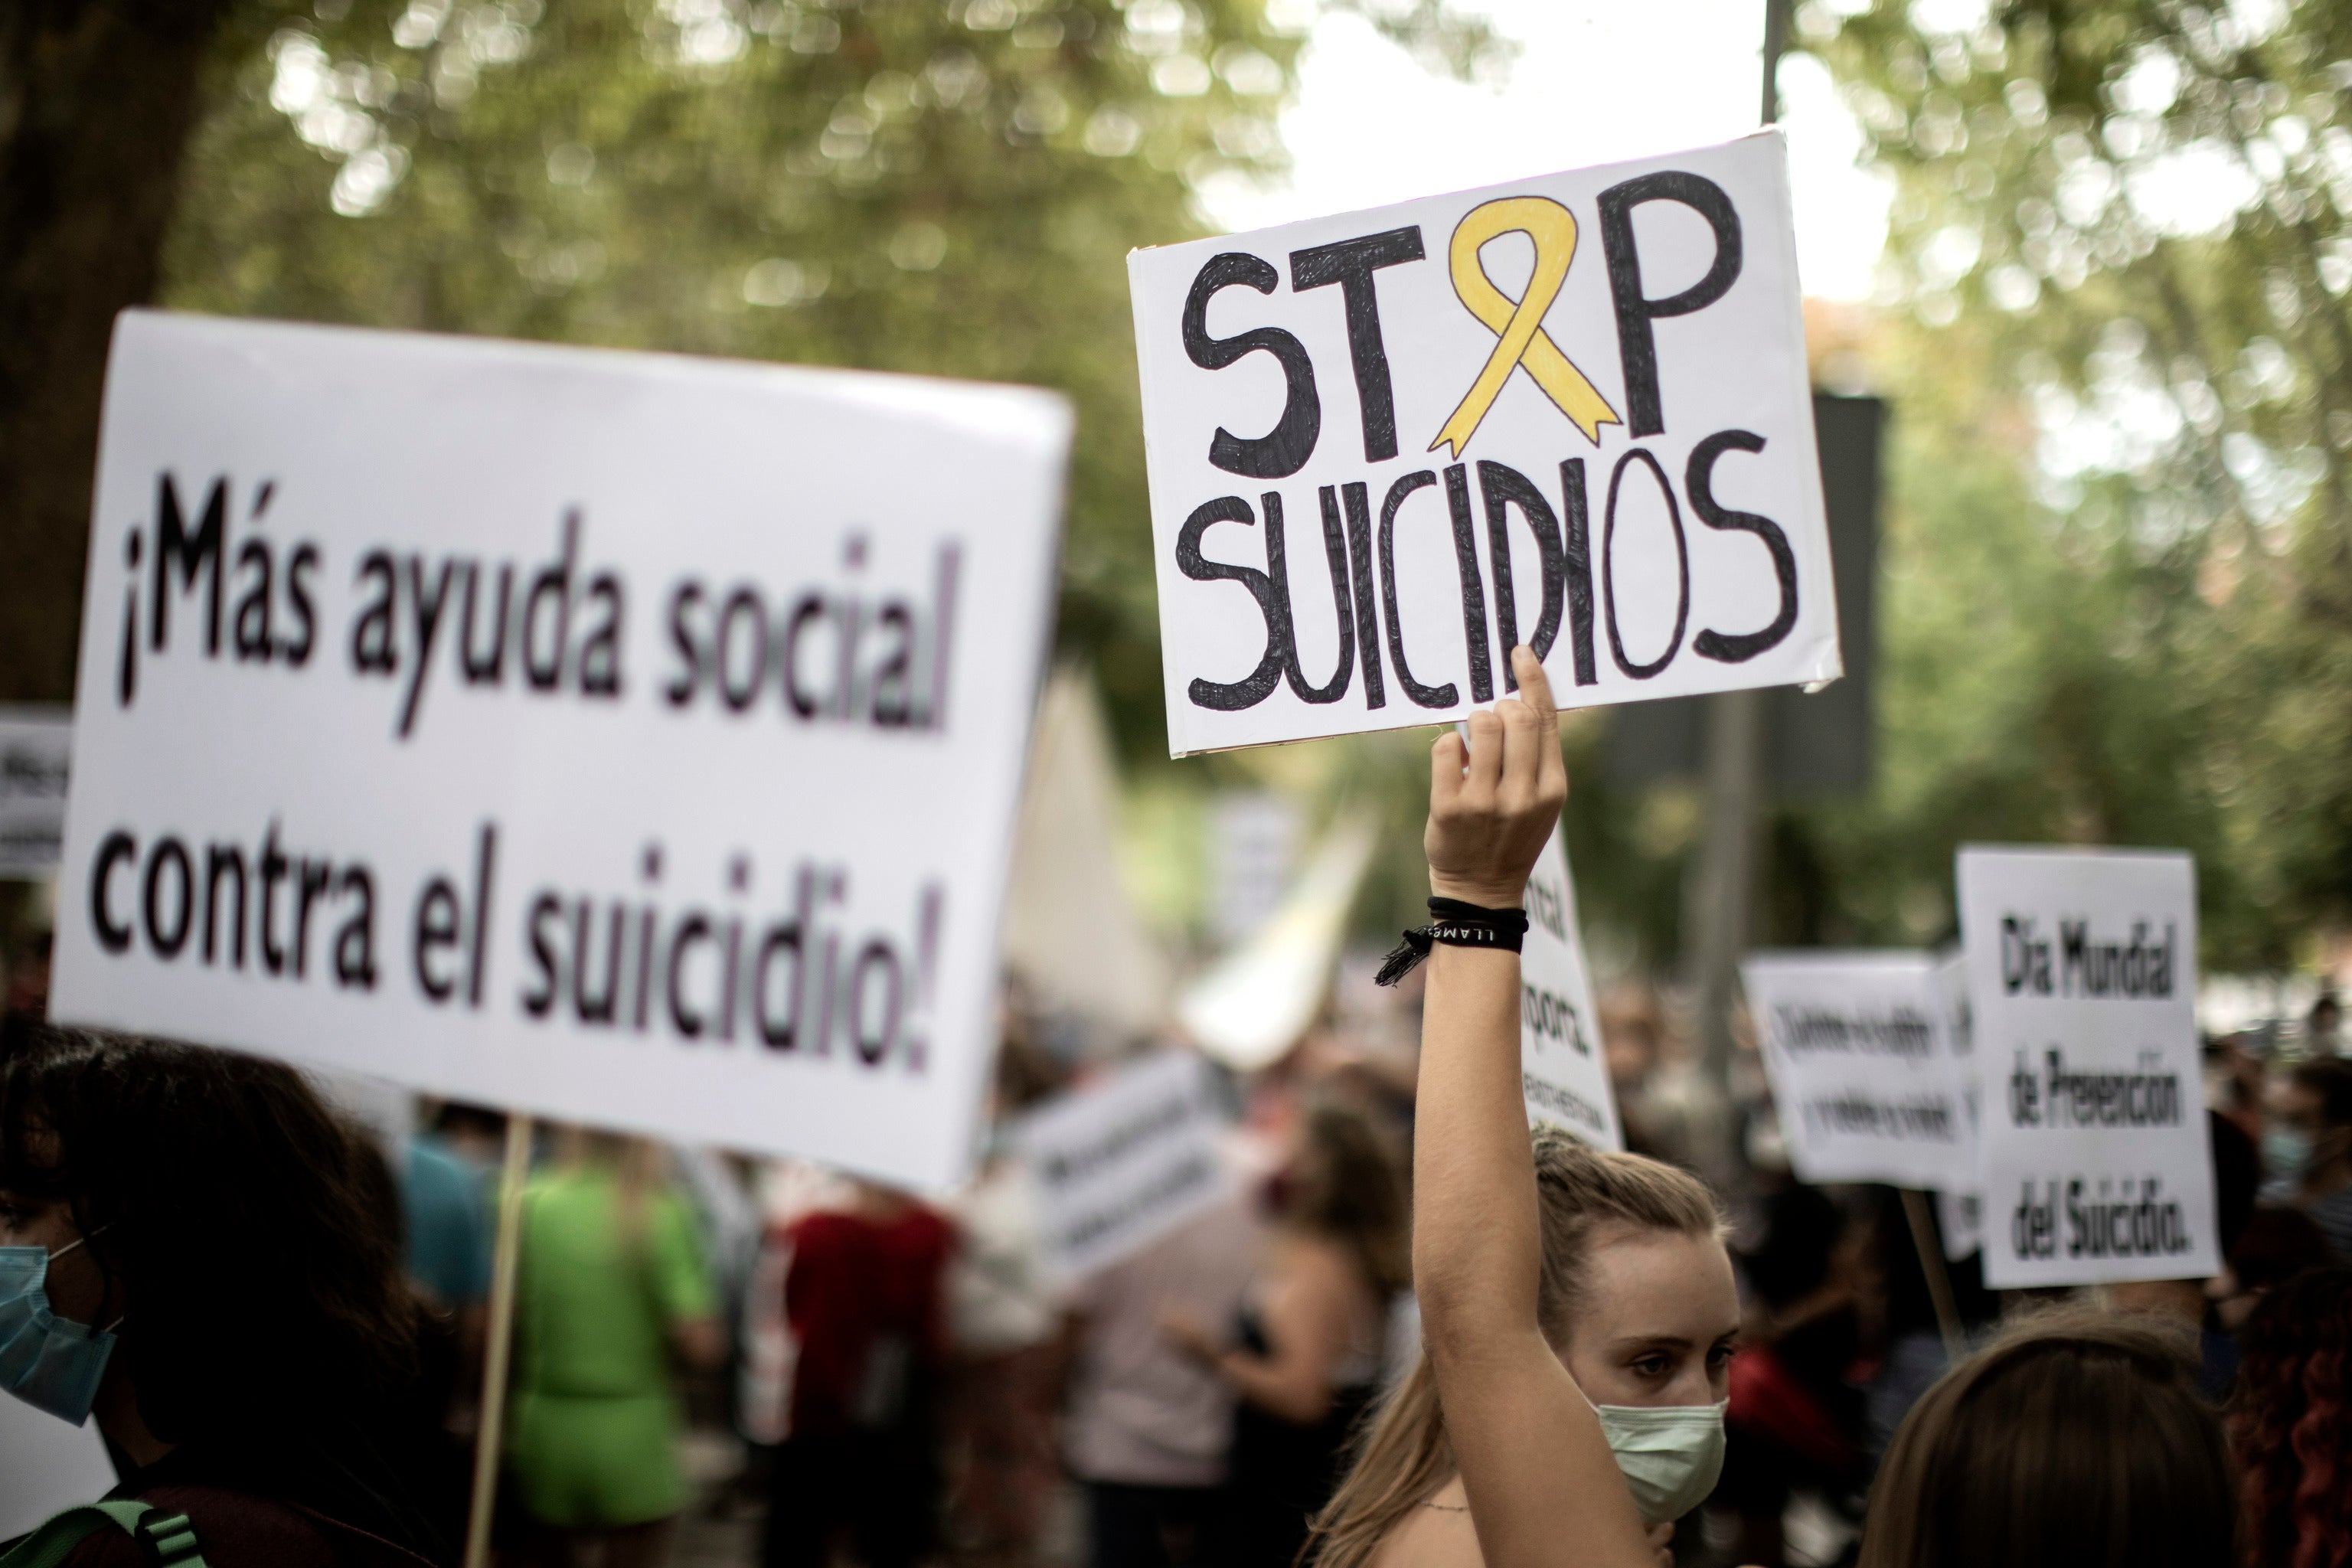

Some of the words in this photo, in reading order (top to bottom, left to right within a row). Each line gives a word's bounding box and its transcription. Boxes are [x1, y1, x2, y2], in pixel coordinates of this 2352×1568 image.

[117, 469, 325, 709] ¡Más
[349, 502, 628, 743] ayuda
[658, 527, 963, 738] social
[1174, 429, 1799, 712] SUICIDIOS
[86, 815, 383, 994] contra
[410, 819, 501, 1012] el
[519, 847, 947, 1075] suicidio!
[2059, 915, 2179, 1000] Mundial
[2009, 1049, 2043, 1130] de
[2012, 1180, 2060, 1261] del
